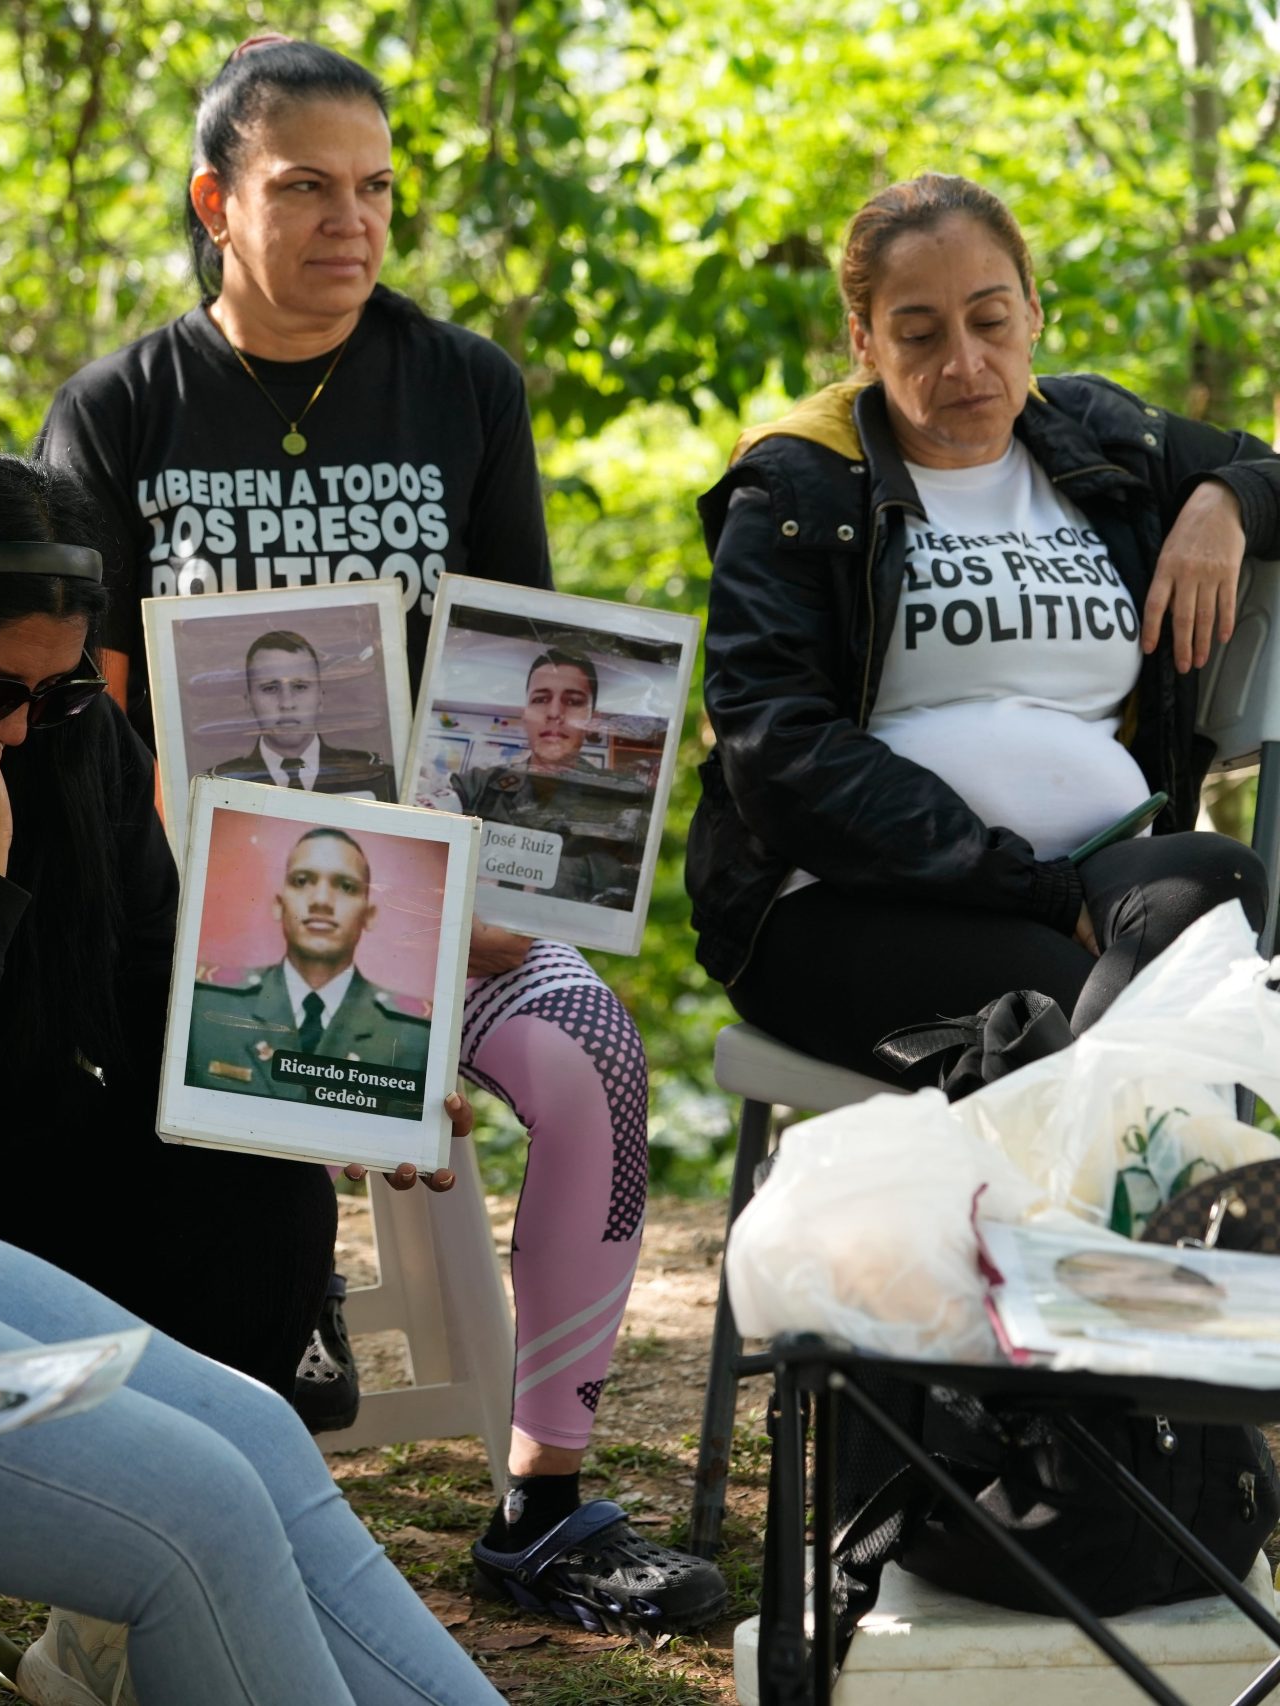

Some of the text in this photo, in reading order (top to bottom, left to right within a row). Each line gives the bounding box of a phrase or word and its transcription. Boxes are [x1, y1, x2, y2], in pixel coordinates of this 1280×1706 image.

[138, 462, 445, 518] LIBEREN A TODOS
[149, 500, 449, 561] LOS PRESOS
[905, 556, 993, 592] LOS
[484, 830, 554, 855] José Ruiz
[485, 857, 543, 880] Gedeon
[280, 1058, 416, 1091] Ricardo Fonseca
[314, 1086, 377, 1108] Gedeòn
